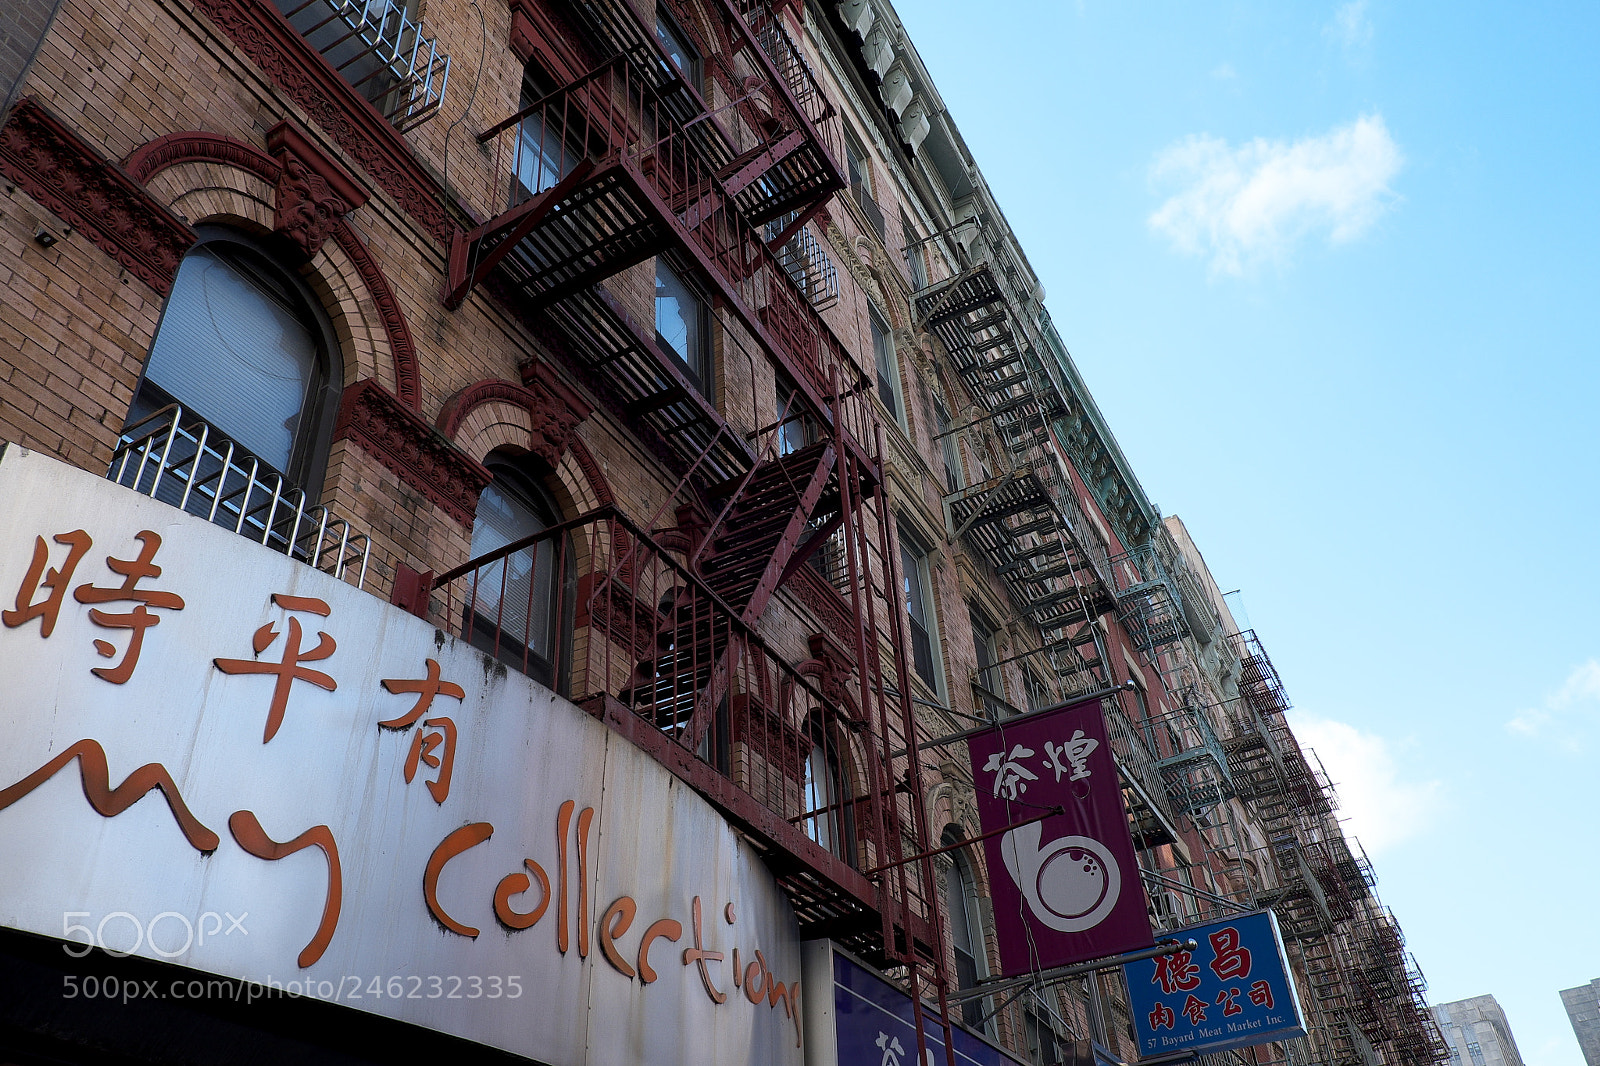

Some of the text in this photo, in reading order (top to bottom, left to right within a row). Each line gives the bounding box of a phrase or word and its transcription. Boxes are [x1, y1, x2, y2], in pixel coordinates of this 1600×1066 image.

[1149, 980, 1275, 1031] 肉食公司
[1147, 1014, 1286, 1049] 57 Bayard Meat Market Inc.
